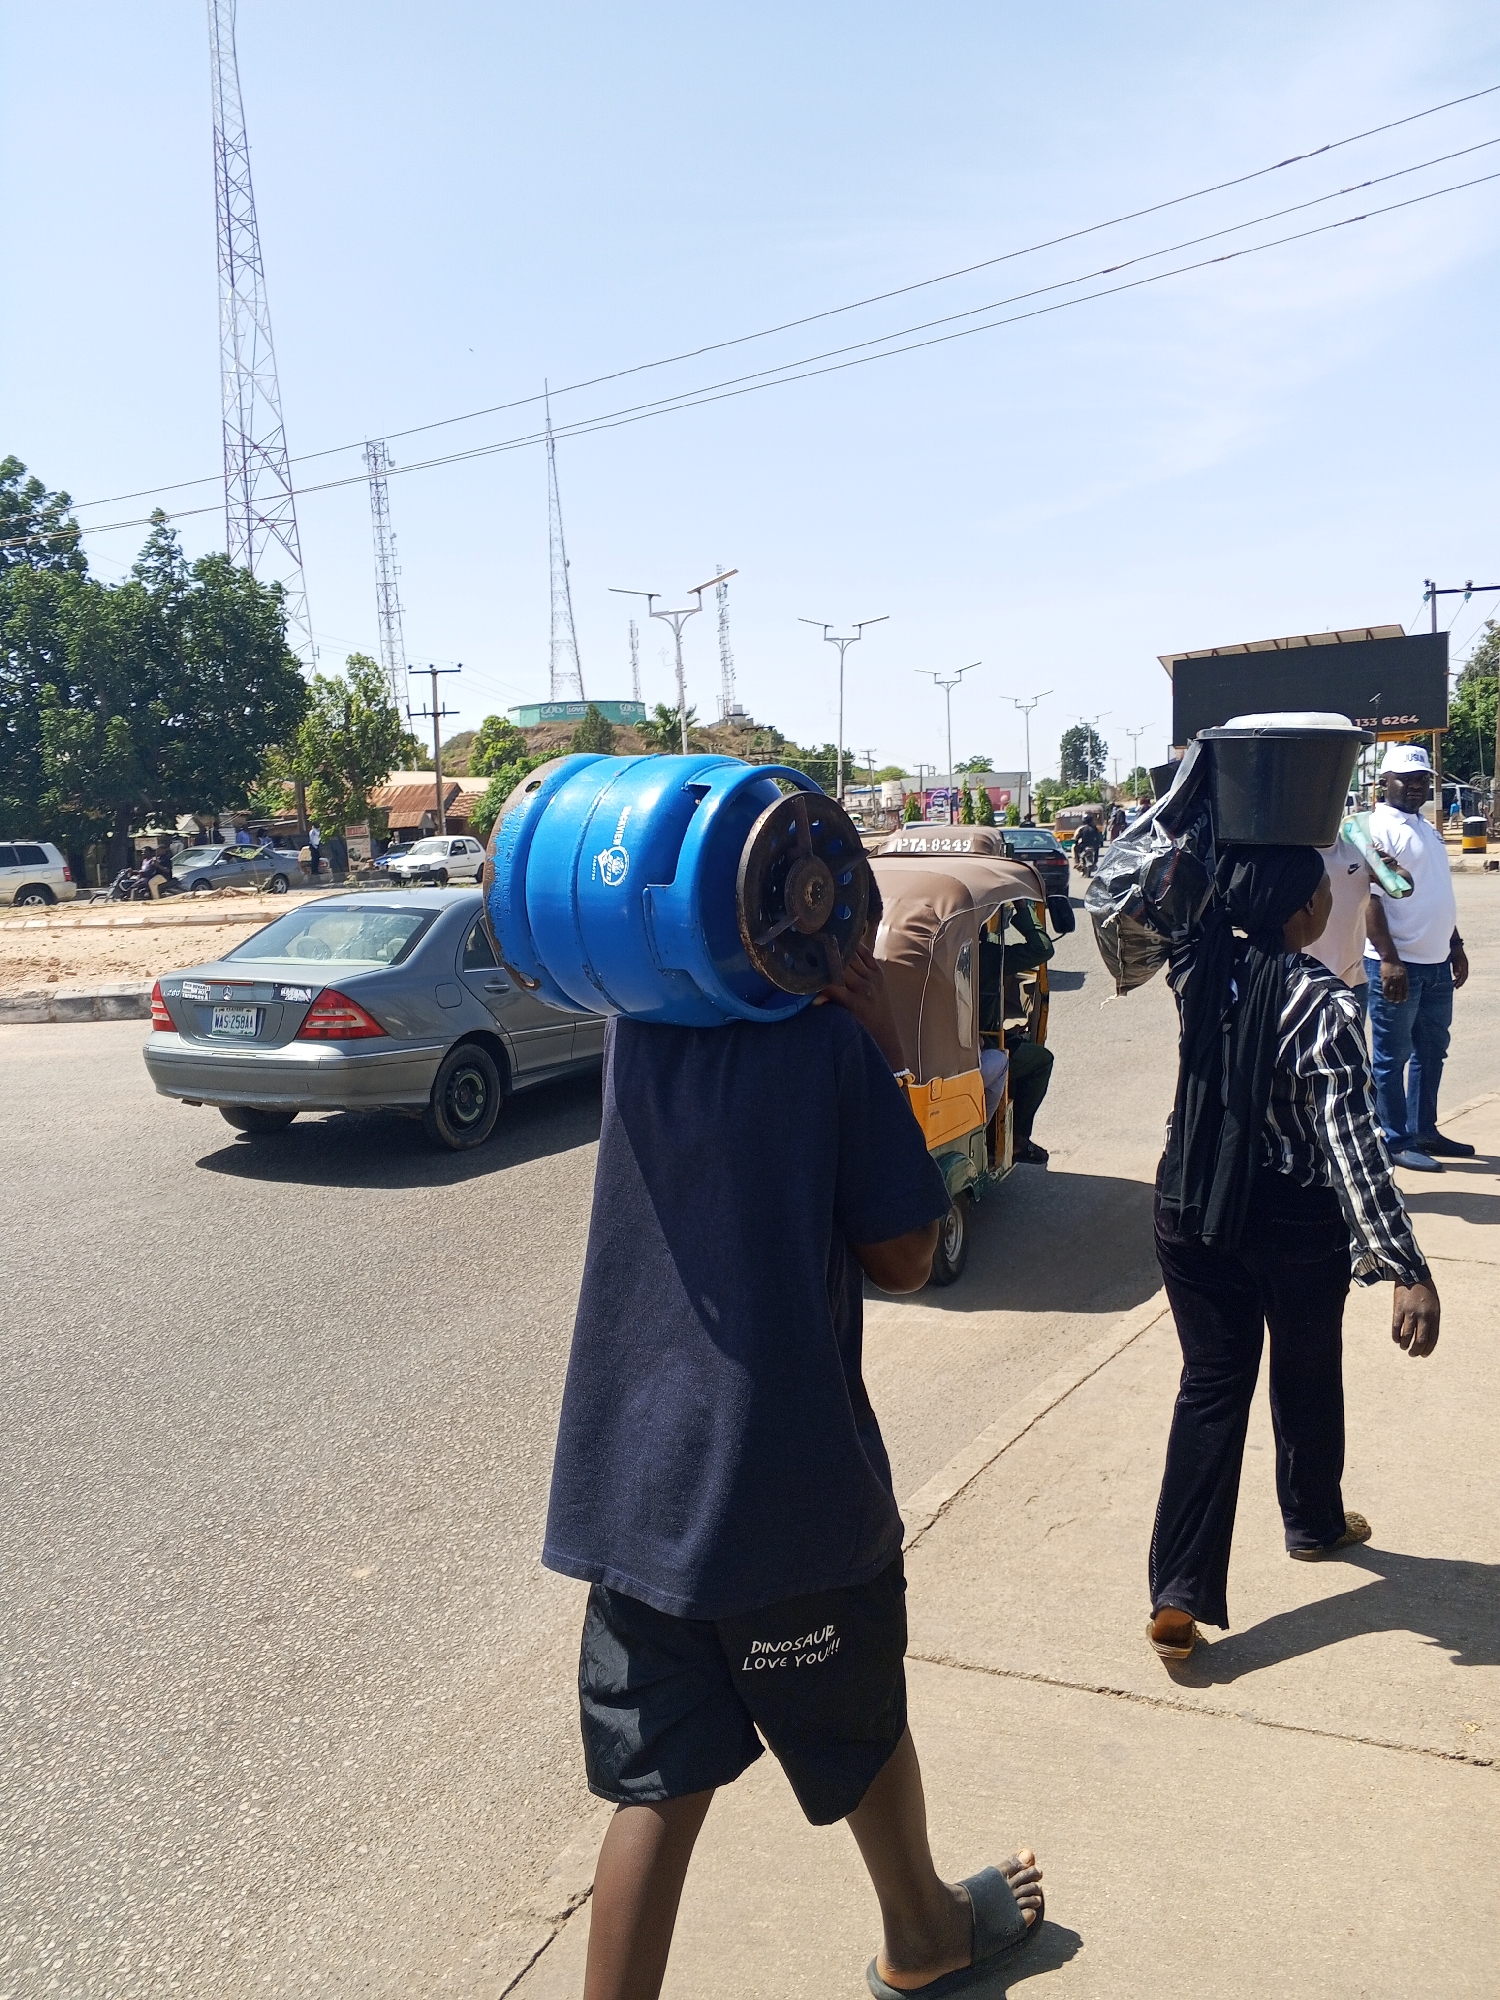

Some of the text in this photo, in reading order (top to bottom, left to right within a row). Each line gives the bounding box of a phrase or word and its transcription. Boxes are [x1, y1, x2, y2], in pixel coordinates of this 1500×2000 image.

[1355, 715, 1419, 727] 133 6264
[750, 1624, 836, 1654] DINOSAUR
[742, 1656, 788, 1671] LOVE
